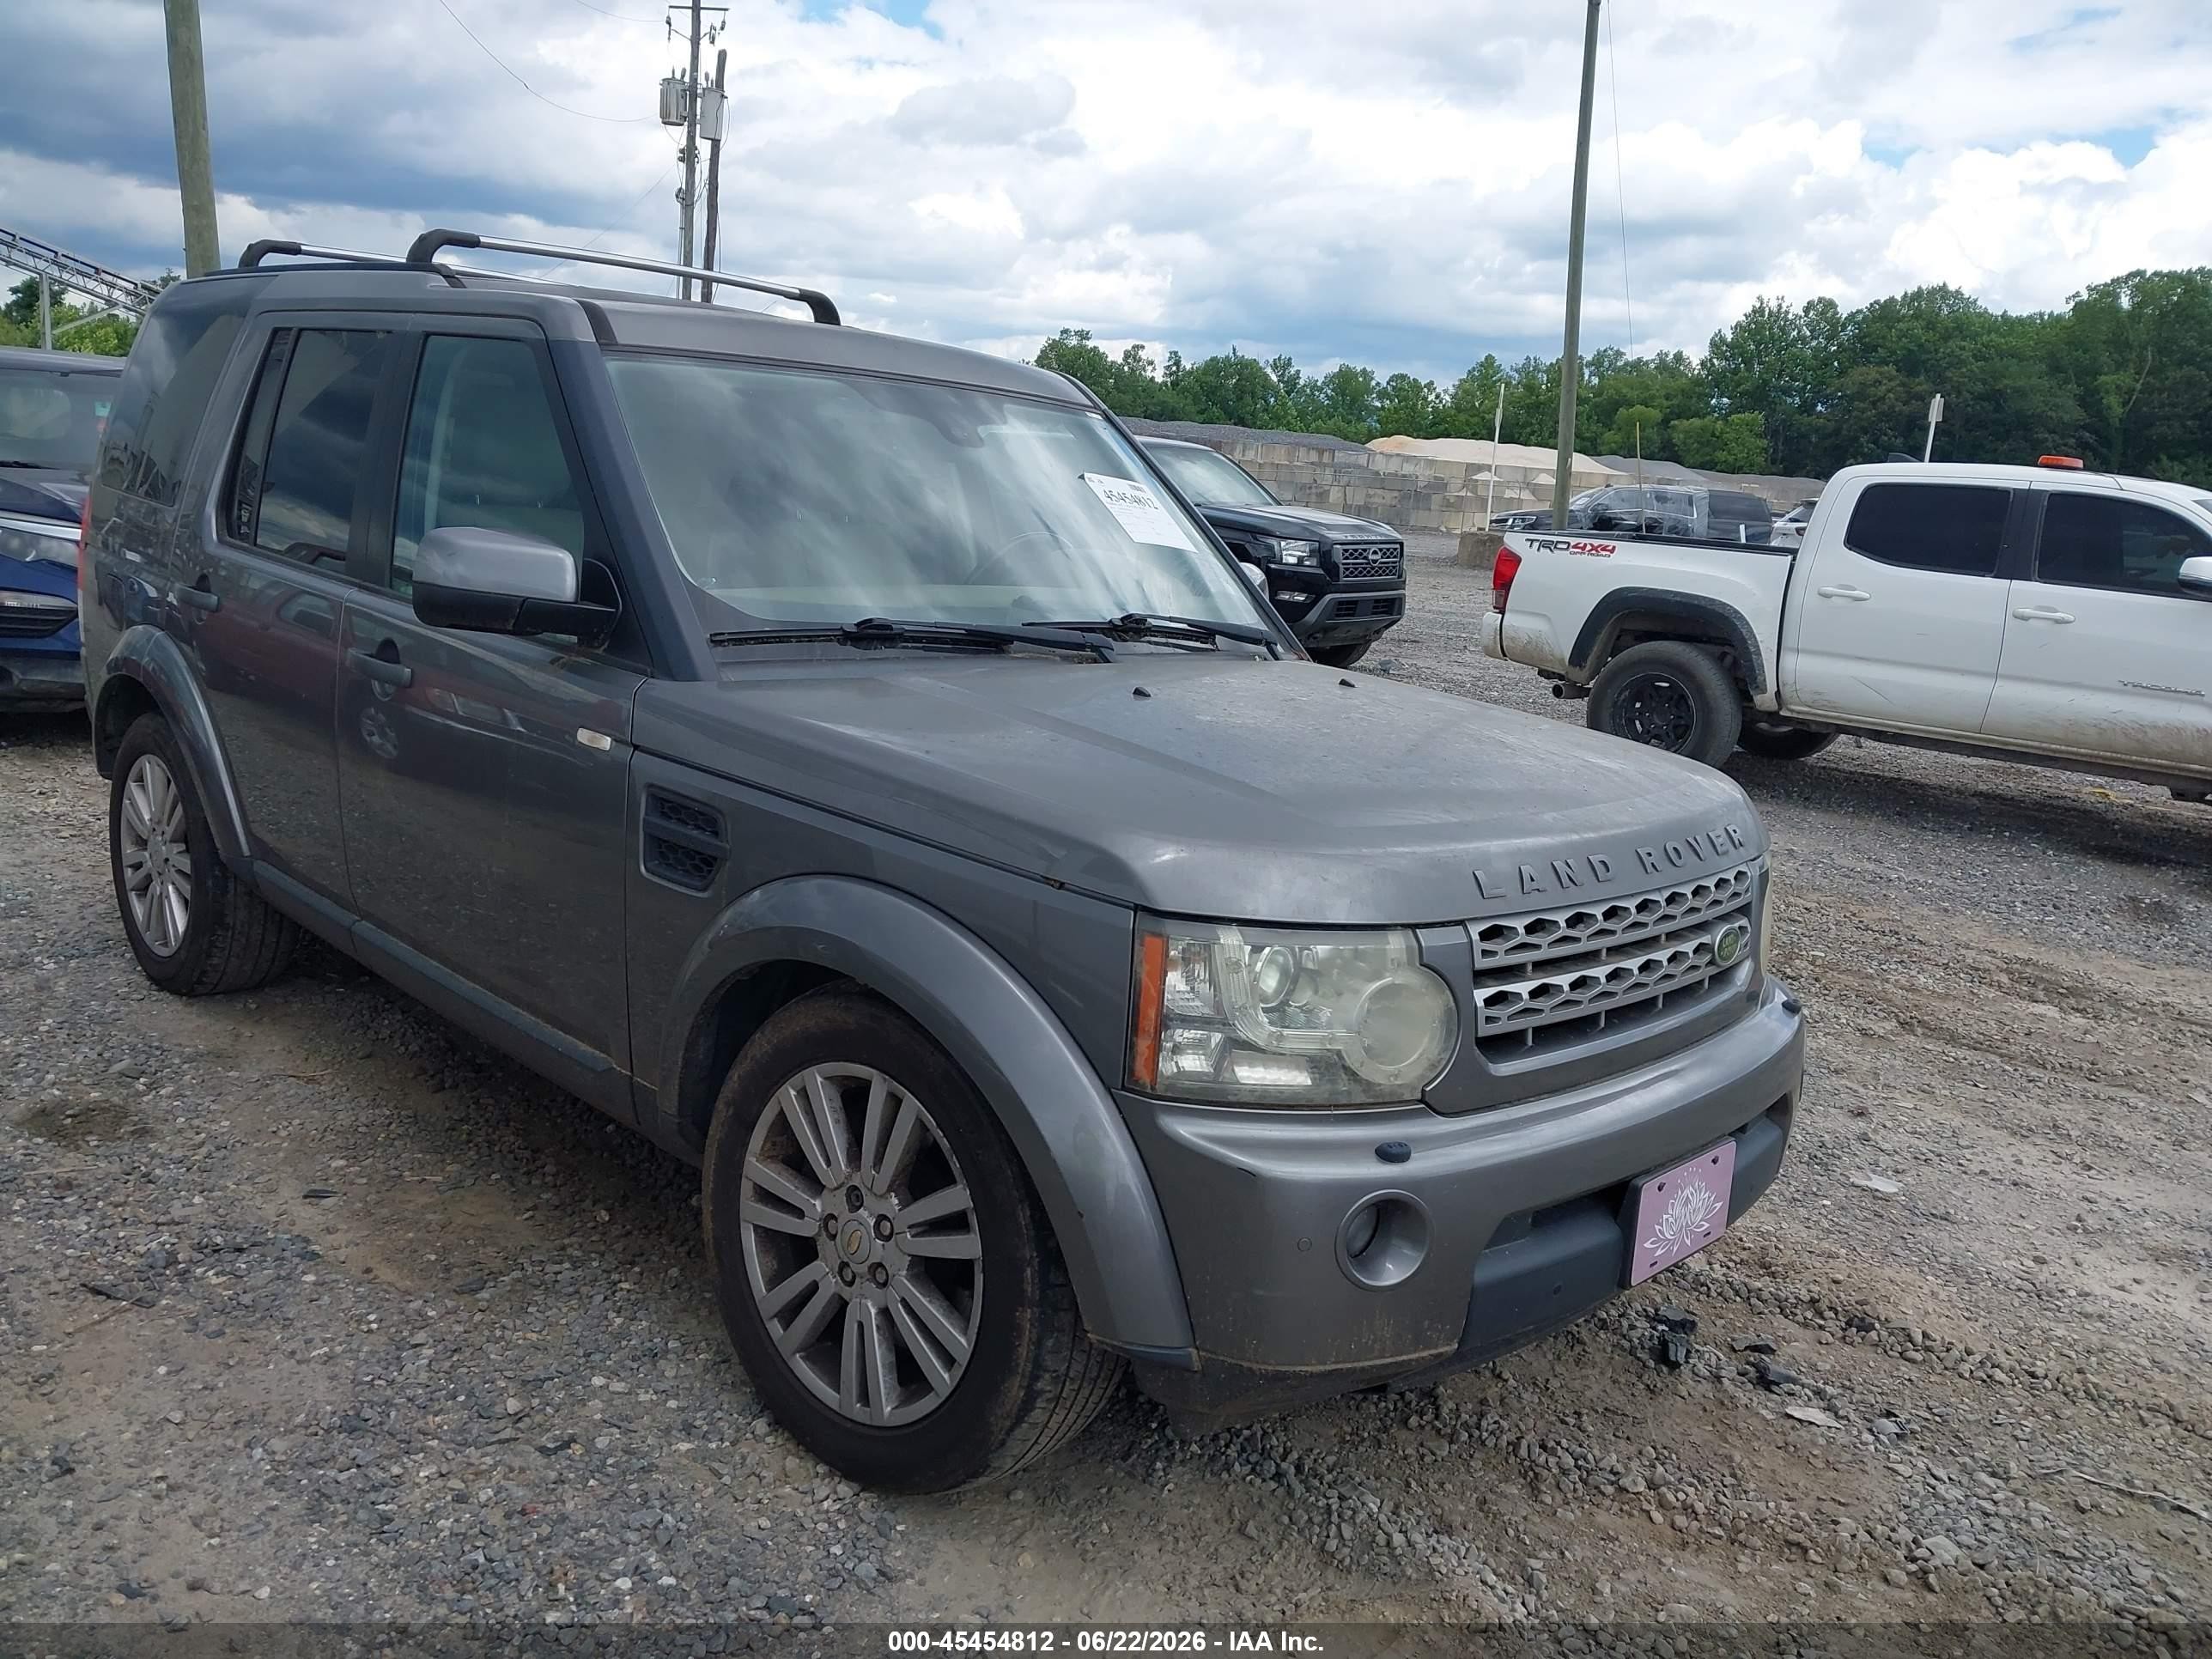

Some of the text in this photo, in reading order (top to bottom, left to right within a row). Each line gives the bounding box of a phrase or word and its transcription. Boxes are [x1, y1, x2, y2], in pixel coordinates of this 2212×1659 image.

[1103, 488, 1159, 510] 45454812
[1473, 823, 1745, 899] LAND ROVER
